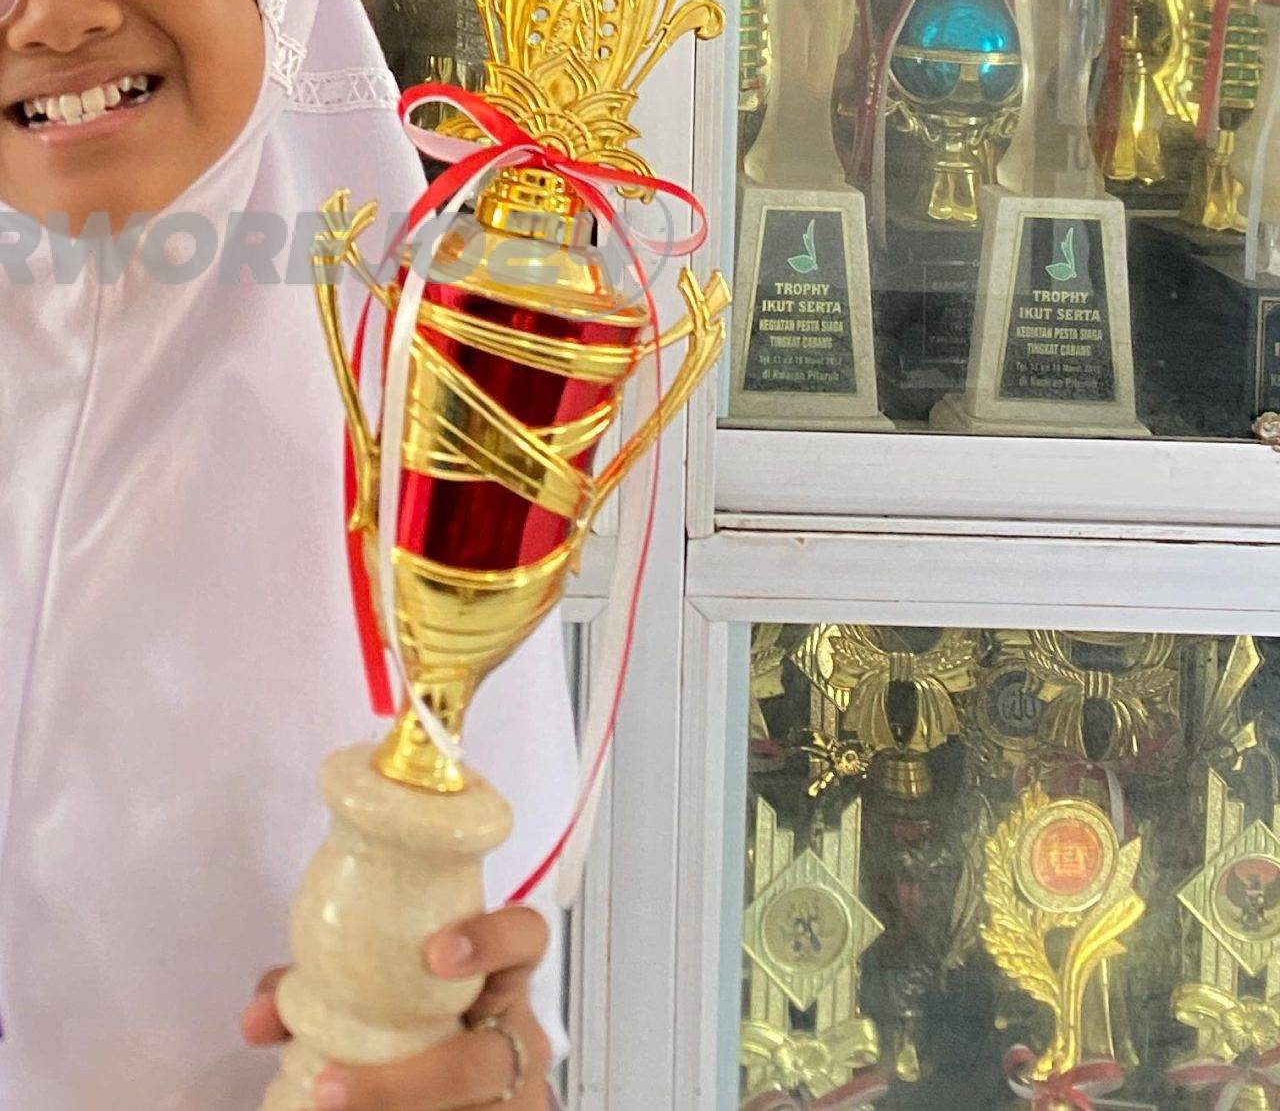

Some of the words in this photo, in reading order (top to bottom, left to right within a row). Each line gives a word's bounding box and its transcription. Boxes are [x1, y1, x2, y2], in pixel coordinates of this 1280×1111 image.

[774, 282, 830, 296] TROPHY
[1032, 290, 1089, 304] TROPHY
[761, 299, 795, 313] IKUT
[798, 300, 842, 314] SERTA
[1019, 307, 1053, 320] IKUT
[1056, 308, 1102, 322] SERTA
[759, 319, 795, 332] KEGIATAN
[797, 319, 820, 332] PESTA
[821, 320, 844, 333] SIAGA
[1016, 326, 1052, 339] KEGIATAN
[1054, 327, 1078, 340] PESTA
[1080, 328, 1103, 341] SIAGA
[769, 336, 800, 348] TINGKAT
[802, 336, 833, 349] CABANG
[1027, 343, 1058, 356] TINGKAT
[1060, 344, 1092, 357] CABANG
